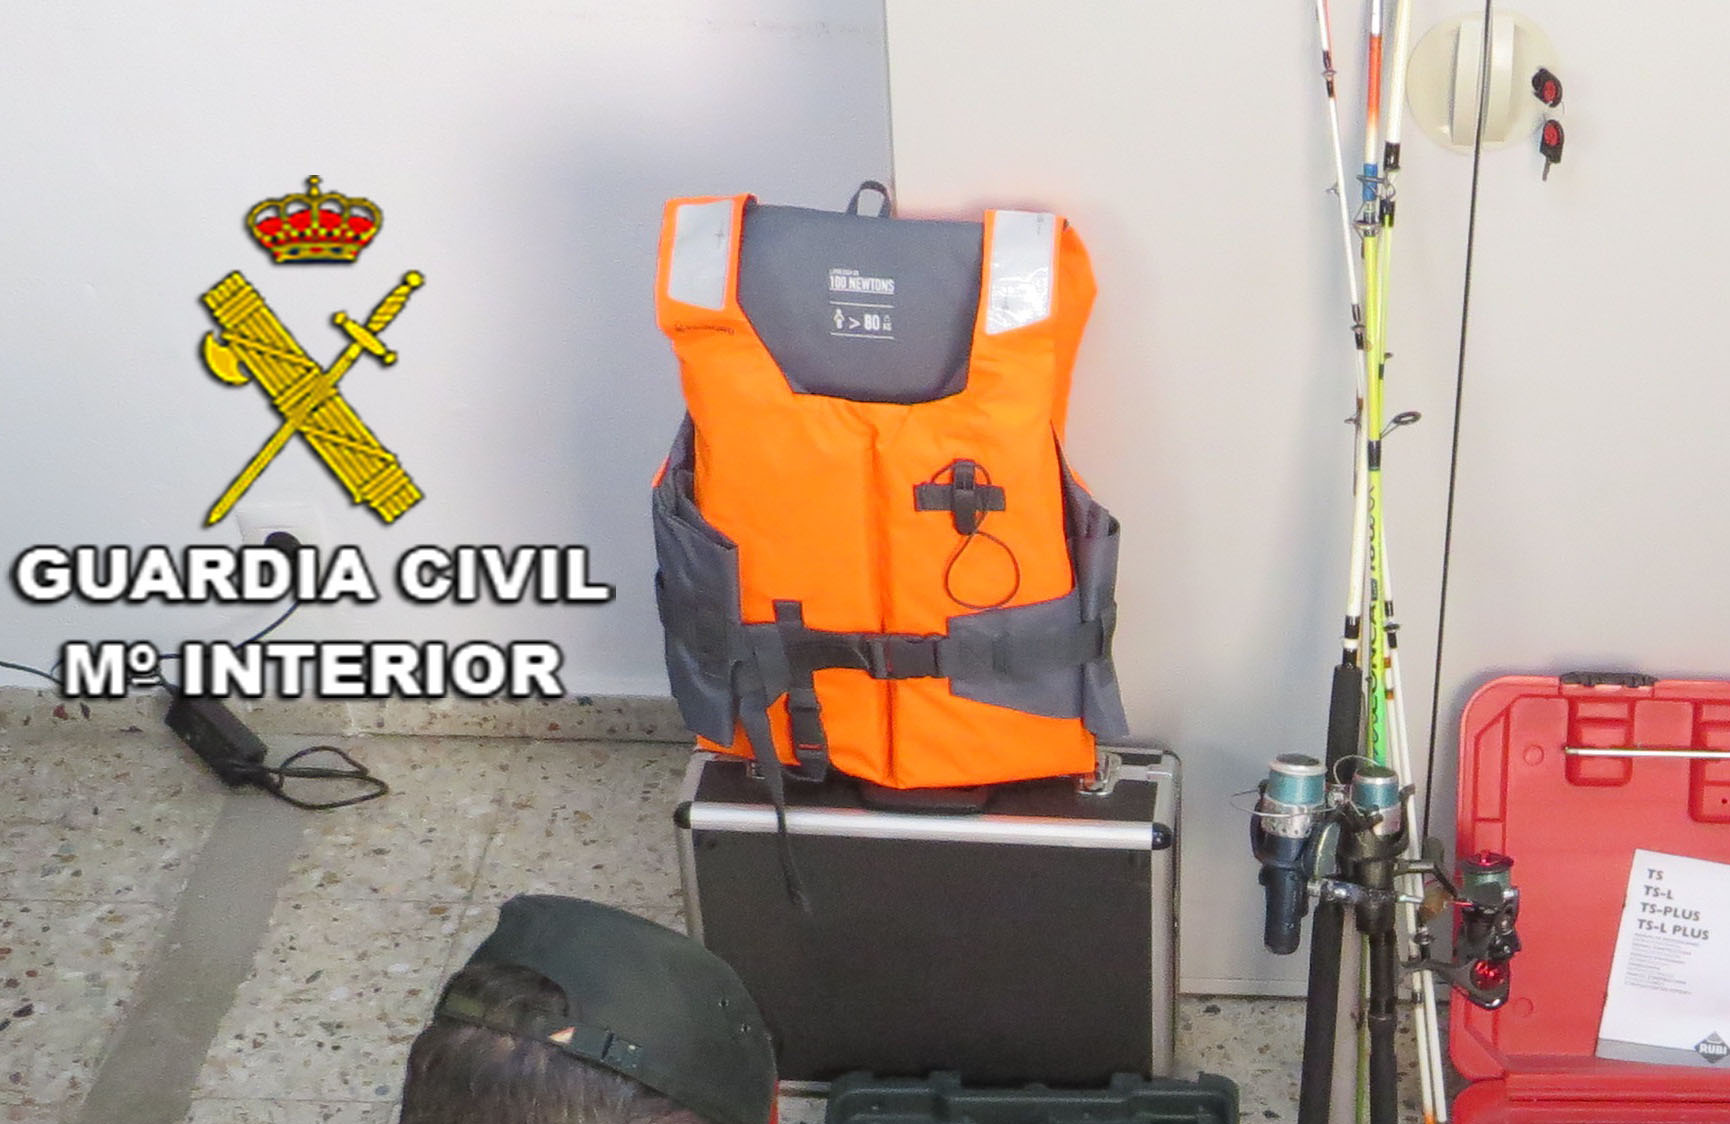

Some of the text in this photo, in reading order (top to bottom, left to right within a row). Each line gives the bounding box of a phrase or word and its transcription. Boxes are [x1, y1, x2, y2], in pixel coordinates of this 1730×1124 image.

[849, 276, 895, 293] NEWTONS
[1647, 868, 1664, 880] TS
[1643, 884, 1674, 900] TS-L
[1640, 902, 1701, 922] TS-PLUS
[1637, 918, 1710, 940] TS-L PLUS
[1699, 1043, 1728, 1056] RUBI
